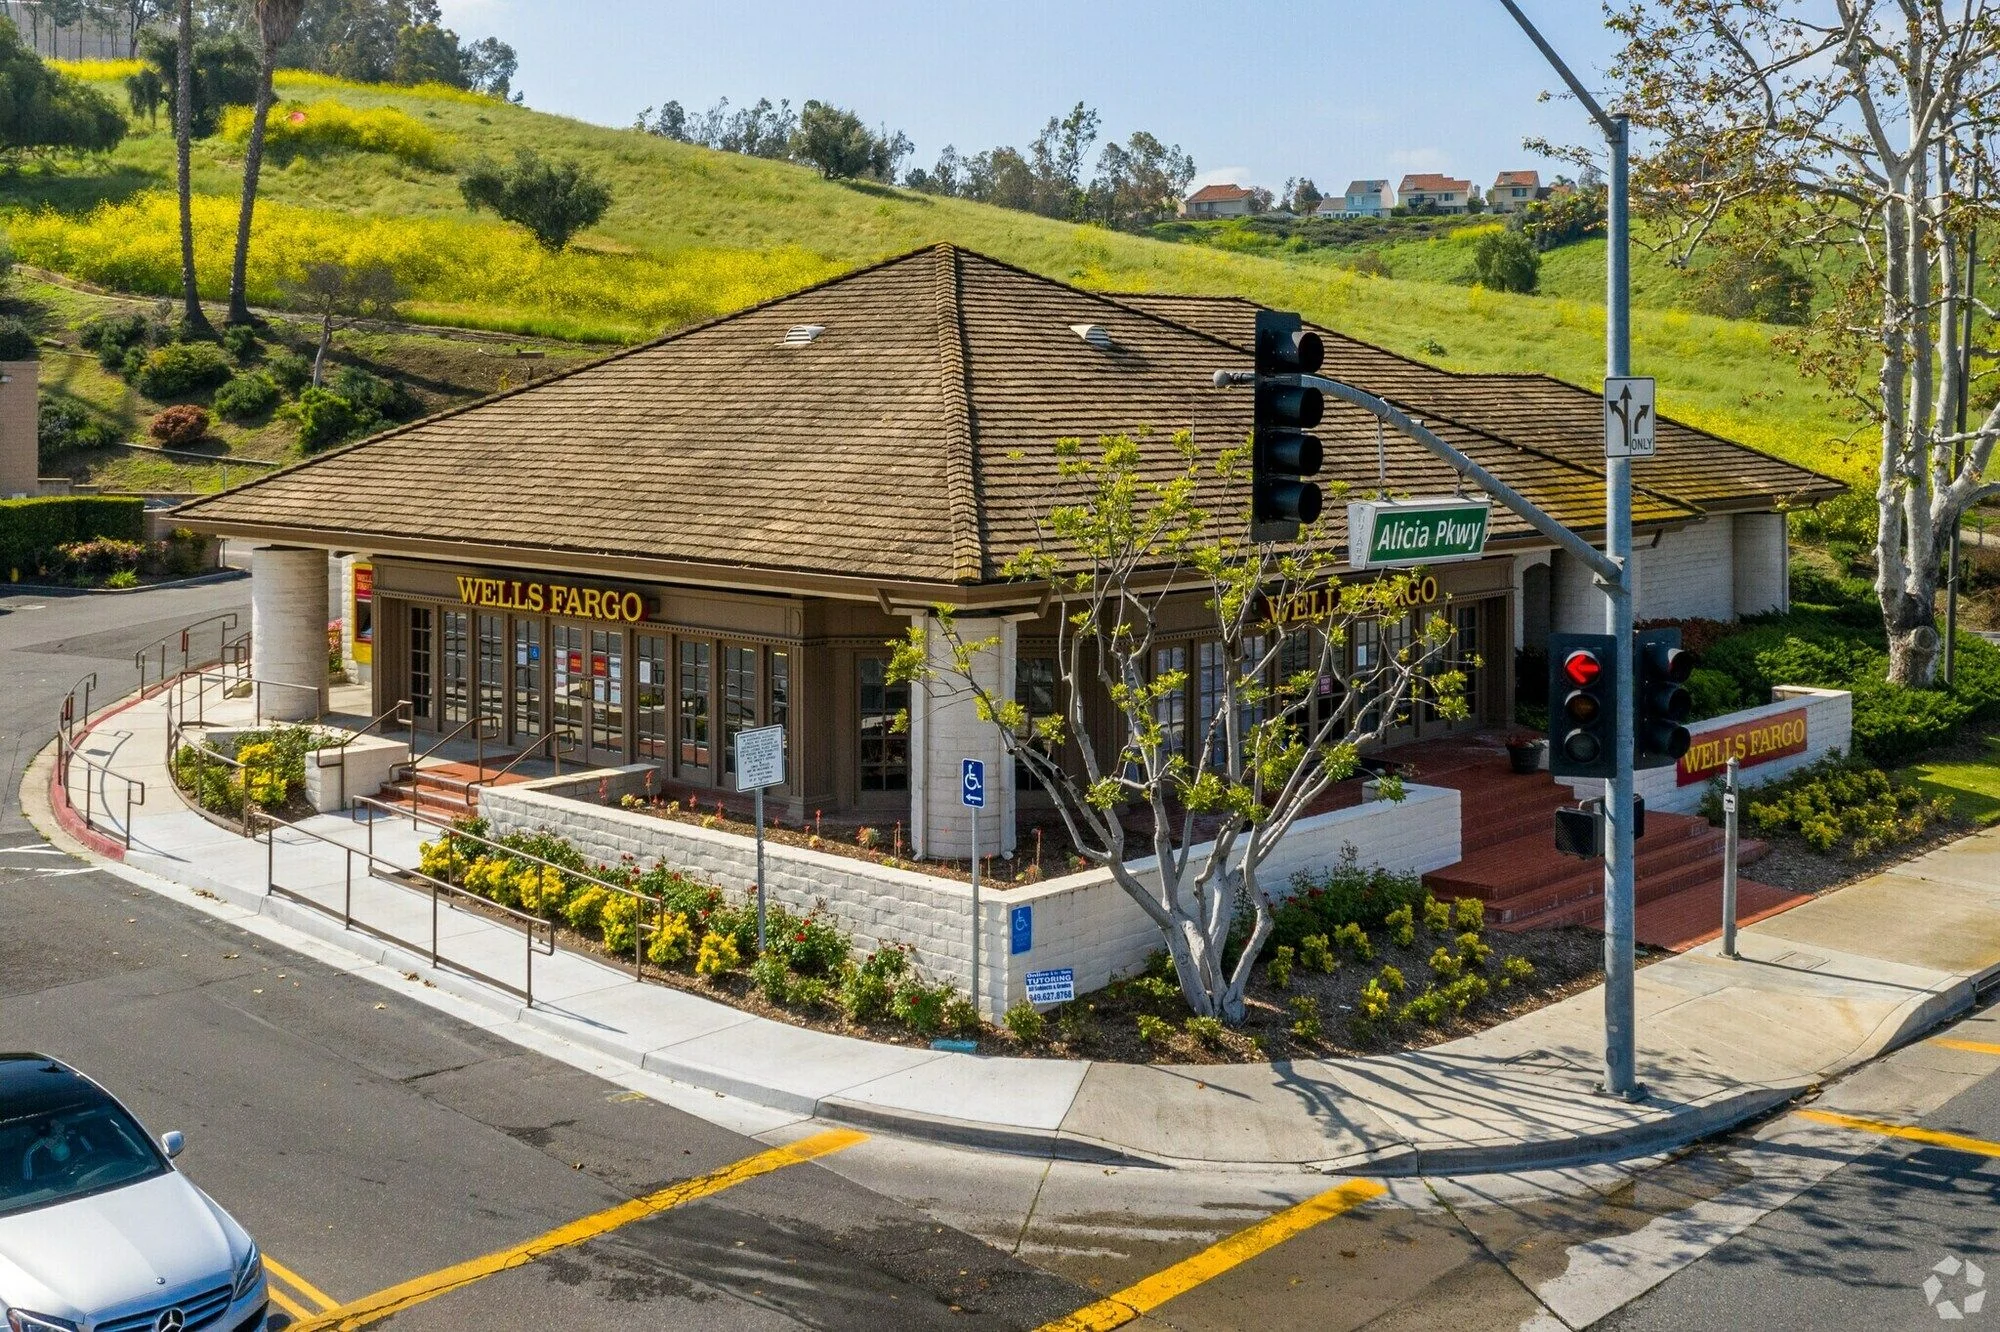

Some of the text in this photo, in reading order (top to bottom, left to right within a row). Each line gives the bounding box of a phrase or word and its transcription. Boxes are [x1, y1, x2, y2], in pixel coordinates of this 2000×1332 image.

[1631, 438, 1652, 450] ONLY
[1377, 519, 1430, 551] Alicia
[1434, 518, 1481, 551] Pkwy
[456, 576, 643, 622] WELLS FARGO
[1267, 588, 1357, 625] WELL
[1684, 718, 1805, 774] WELLS FARGO
[1027, 975, 1071, 985] TUTORING
